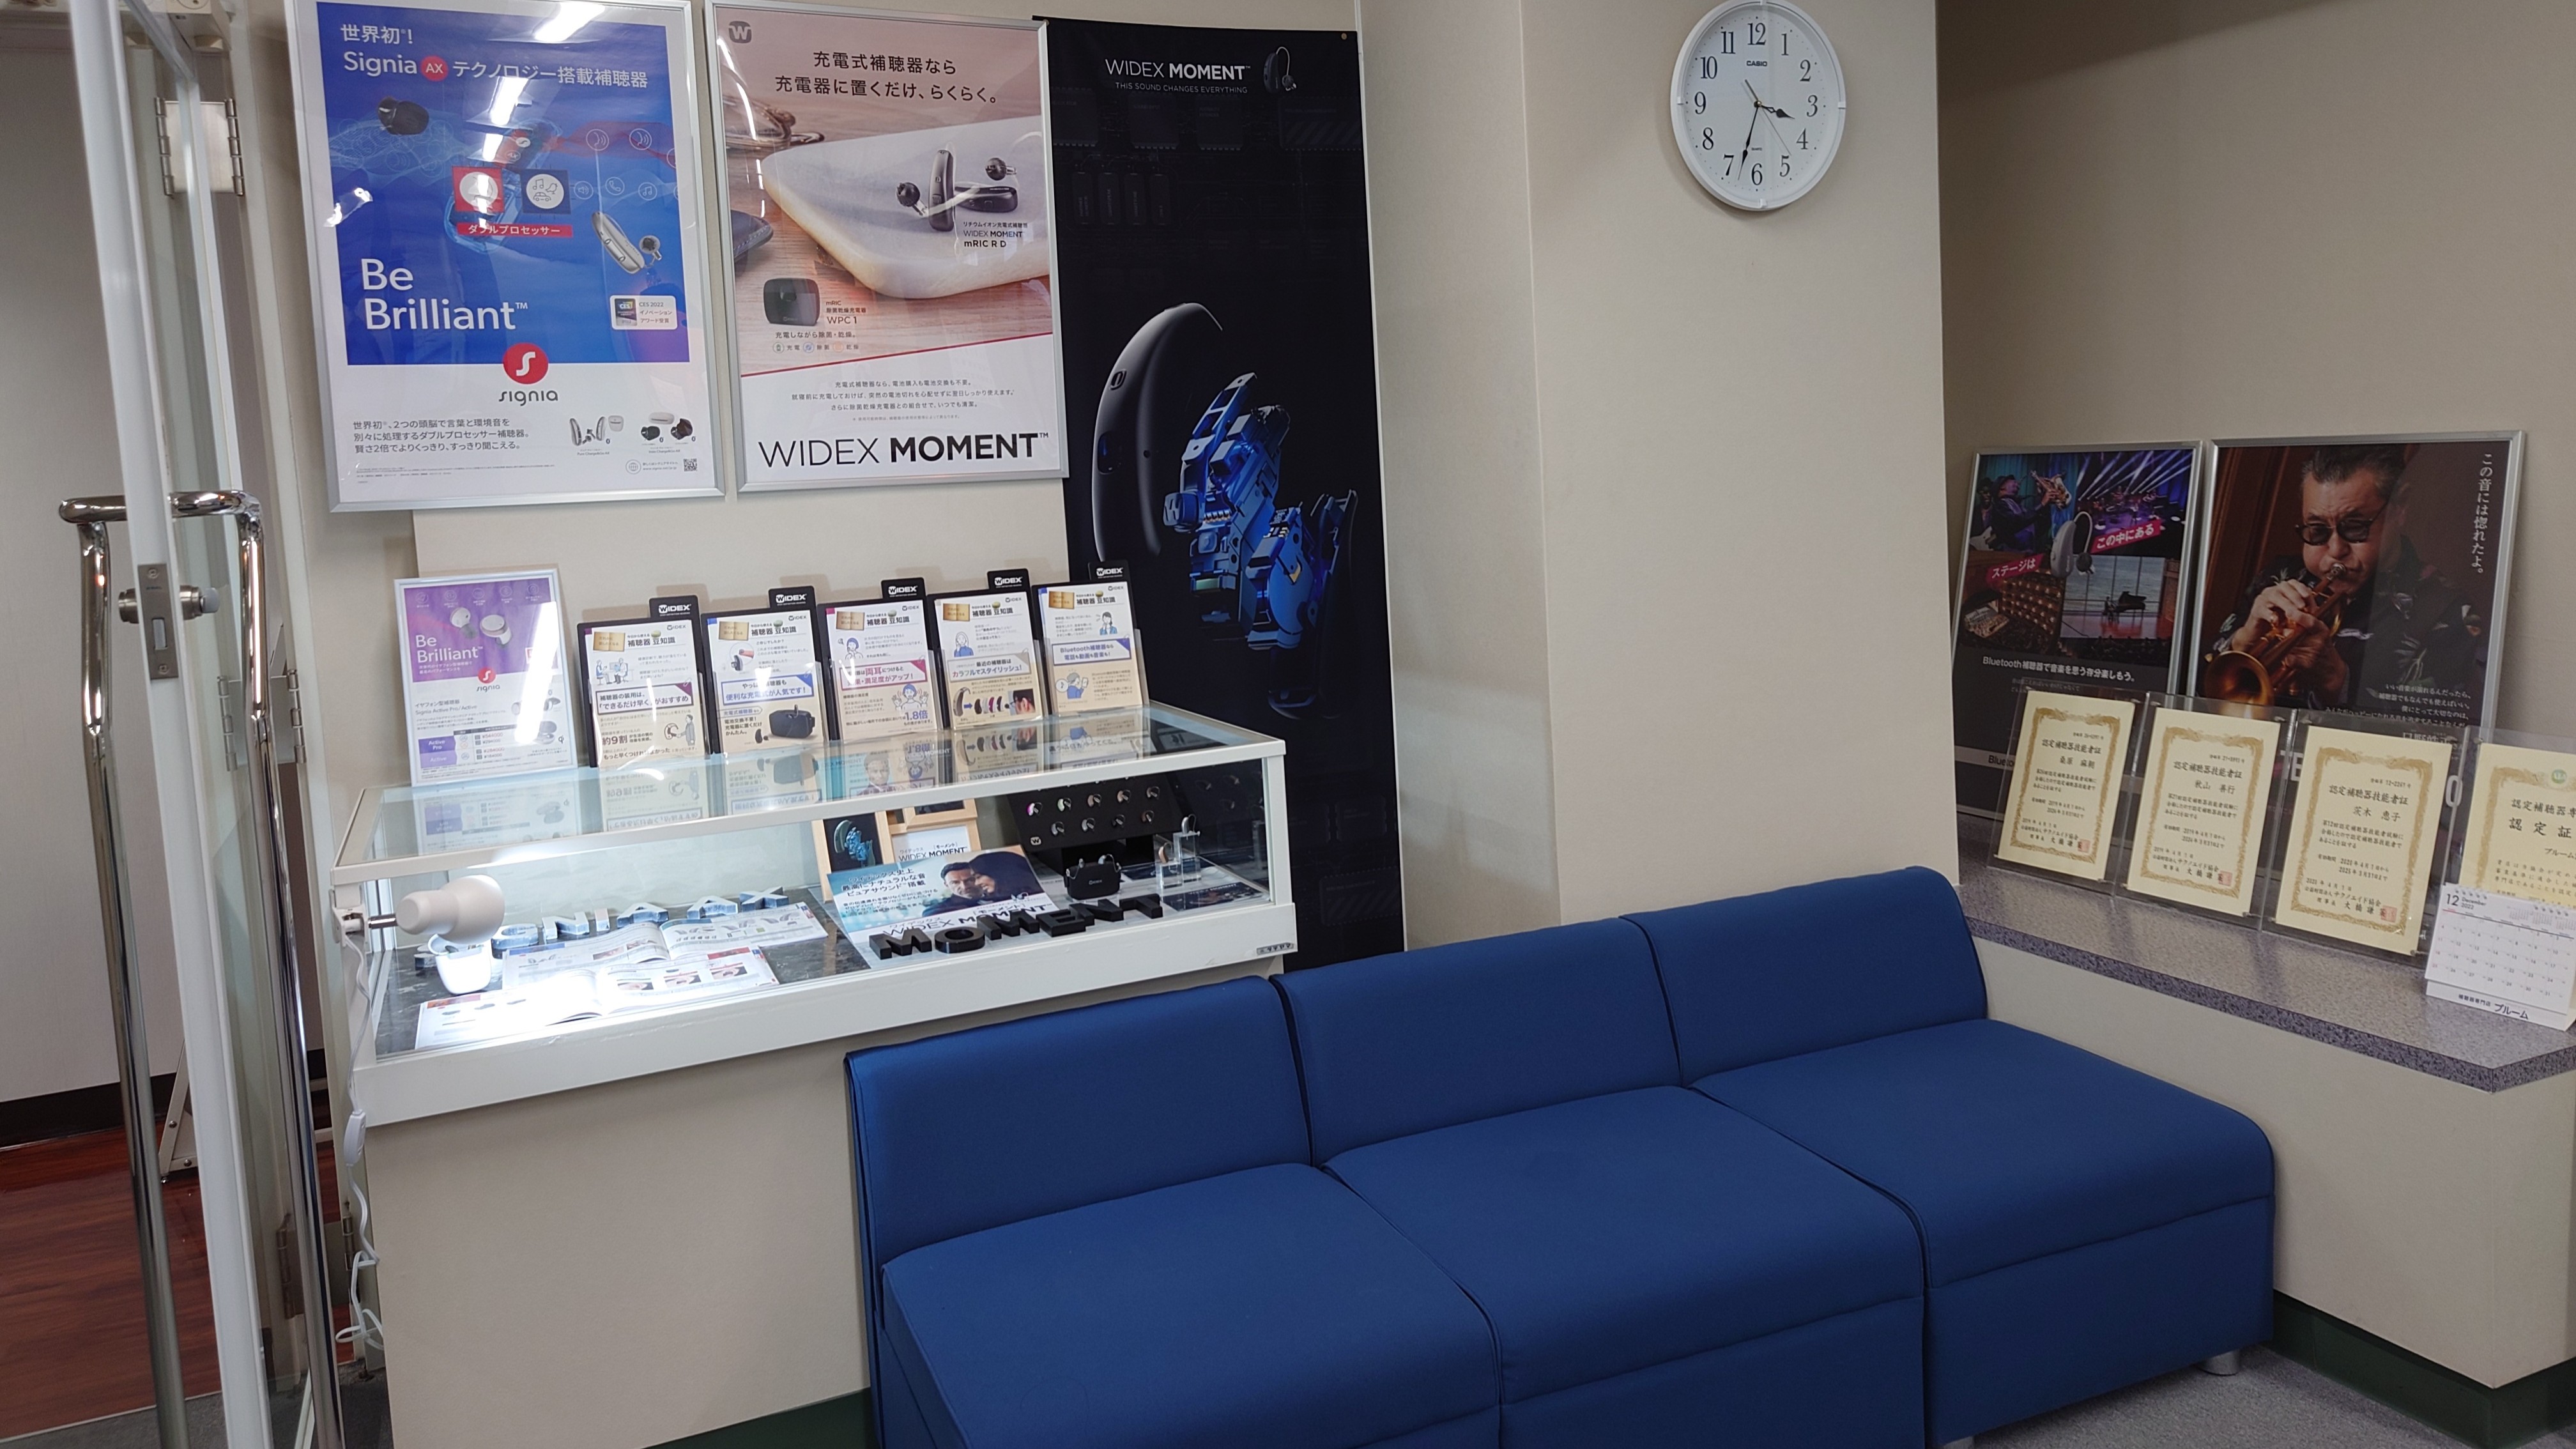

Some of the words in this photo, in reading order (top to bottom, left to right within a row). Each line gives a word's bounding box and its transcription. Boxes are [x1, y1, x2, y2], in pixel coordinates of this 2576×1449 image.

[1721, 31, 1735, 54] 11
[1747, 23, 1766, 45] 12
[1781, 33, 1789, 56] 1
[344, 51, 418, 77] Signia
[425, 62, 443, 74] AX
[452, 61, 648, 89] テクノロジー搭載補聴器
[813, 50, 957, 75] 充電式補聴器なら
[1105, 59, 1165, 77] WIDEX
[1700, 56, 1717, 79] 10
[1800, 59, 1811, 82] 2
[775, 75, 997, 104] 充電器に置くだけ、らくらく。
[1116, 82, 1133, 90] THIS
[1135, 83, 1161, 91] SOUND
[1163, 84, 1199, 93] CHANGES
[1200, 86, 1248, 94] EVERYTHING
[1694, 92, 1706, 114] 9
[1807, 95, 1818, 117] 3
[1703, 127, 1713, 150] 8
[1797, 128, 1808, 150] 4
[1723, 155, 1734, 176] 7
[1751, 164, 1763, 185] 6
[1780, 155, 1790, 177] 5
[361, 258, 413, 290] Be
[498, 389, 559, 406] signia
[758, 438, 880, 468] WIDEX
[2471, 453, 2493, 574] この音には惚れたよ。
[2096, 523, 2154, 549] この中にある
[1096, 567, 1123, 576] WIDEX
[1991, 558, 2036, 579] ステージは
[888, 586, 917, 595] WIDEX
[994, 577, 1022, 585] WIDEX
[659, 604, 691, 613] WIDEX
[776, 594, 807, 603] WIDEX
[416, 635, 437, 648] Be
[1061, 644, 1114, 653] Bluetooth補聴器なら
[477, 684, 500, 693] signia
[600, 692, 645, 701] 補聴器の装用は、
[905, 710, 928, 721] 1.8倍
[602, 735, 627, 745] 約9割
[604, 747, 670, 760] もっと早くつけれよかった
[2173, 761, 2242, 779] 認定補聴器技能者証
[2329, 785, 2409, 805] 認定補聴器技能者証
[2446, 894, 2459, 906] 12
[2462, 897, 2486, 906] December
[869, 893, 1163, 960] MOMENT
[2494, 1002, 2529, 1020] ブルーム
